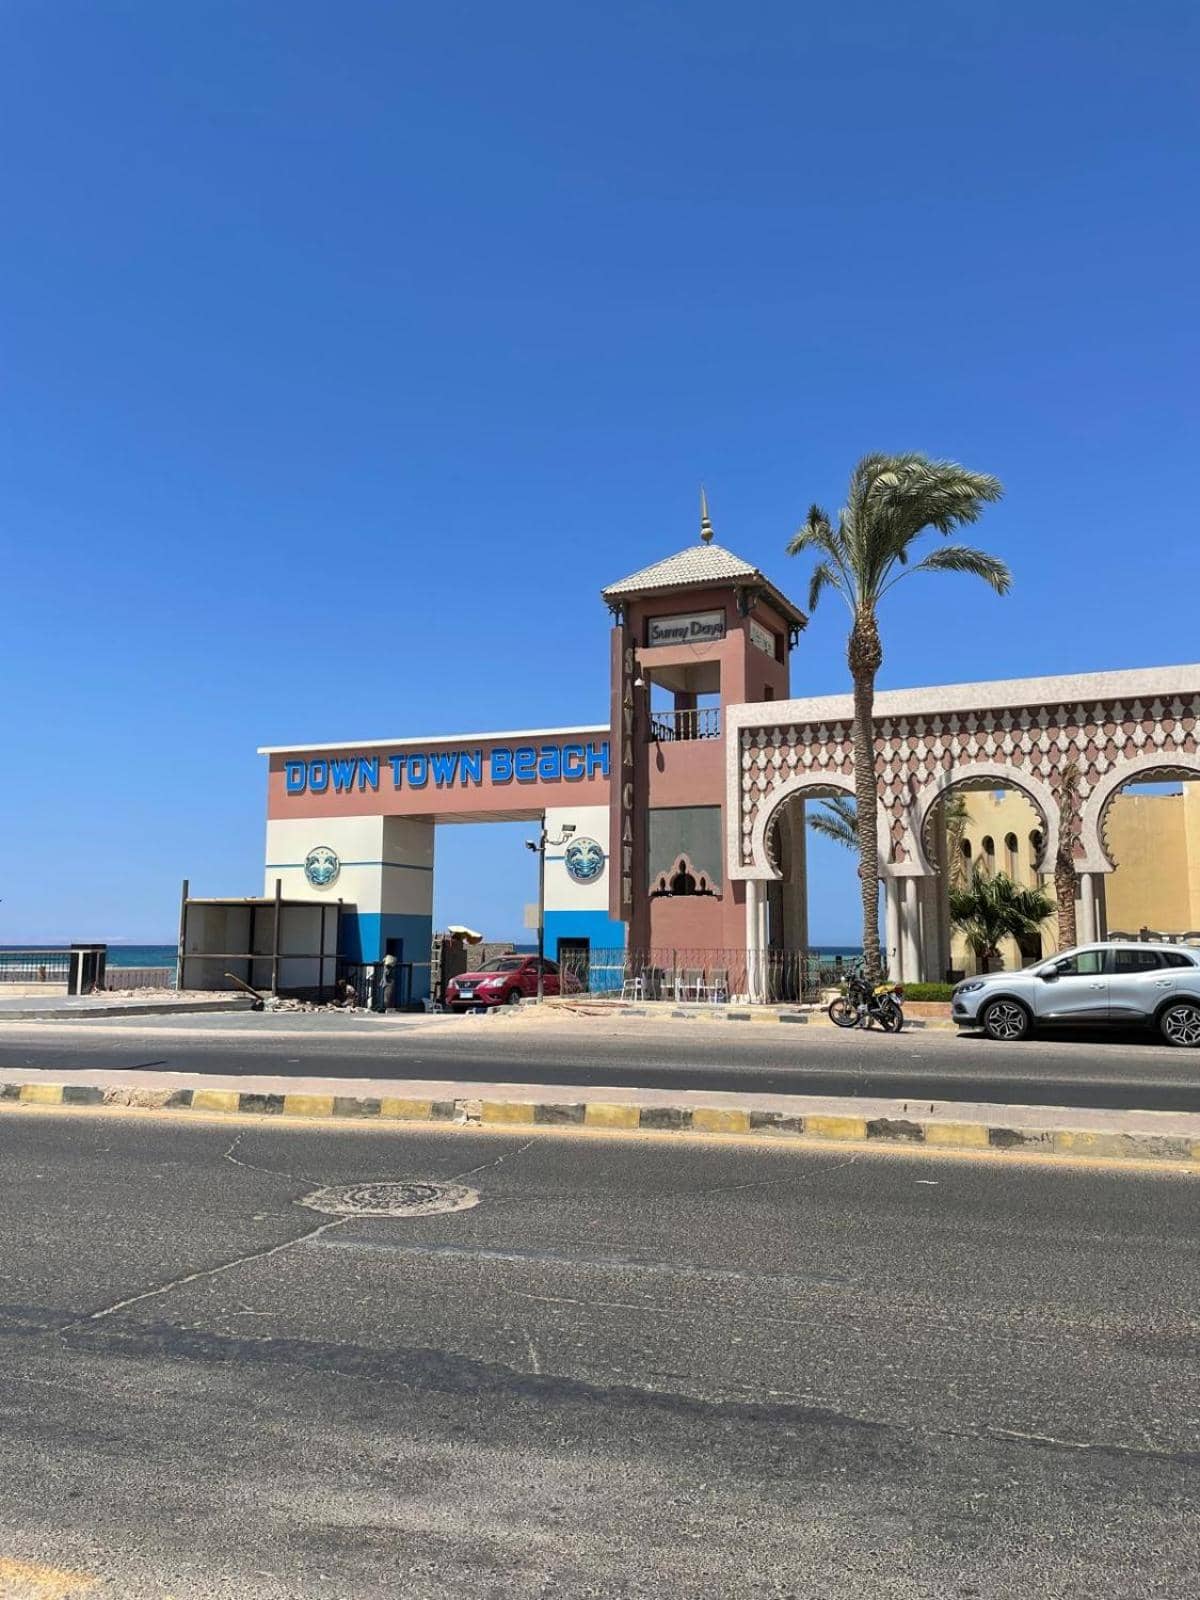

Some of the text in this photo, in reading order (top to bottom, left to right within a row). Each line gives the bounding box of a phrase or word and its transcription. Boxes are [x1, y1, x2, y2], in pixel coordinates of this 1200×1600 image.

[652, 624, 689, 640] Sunny
[285, 757, 380, 792] DOWN
[389, 751, 482, 787] TOWN
